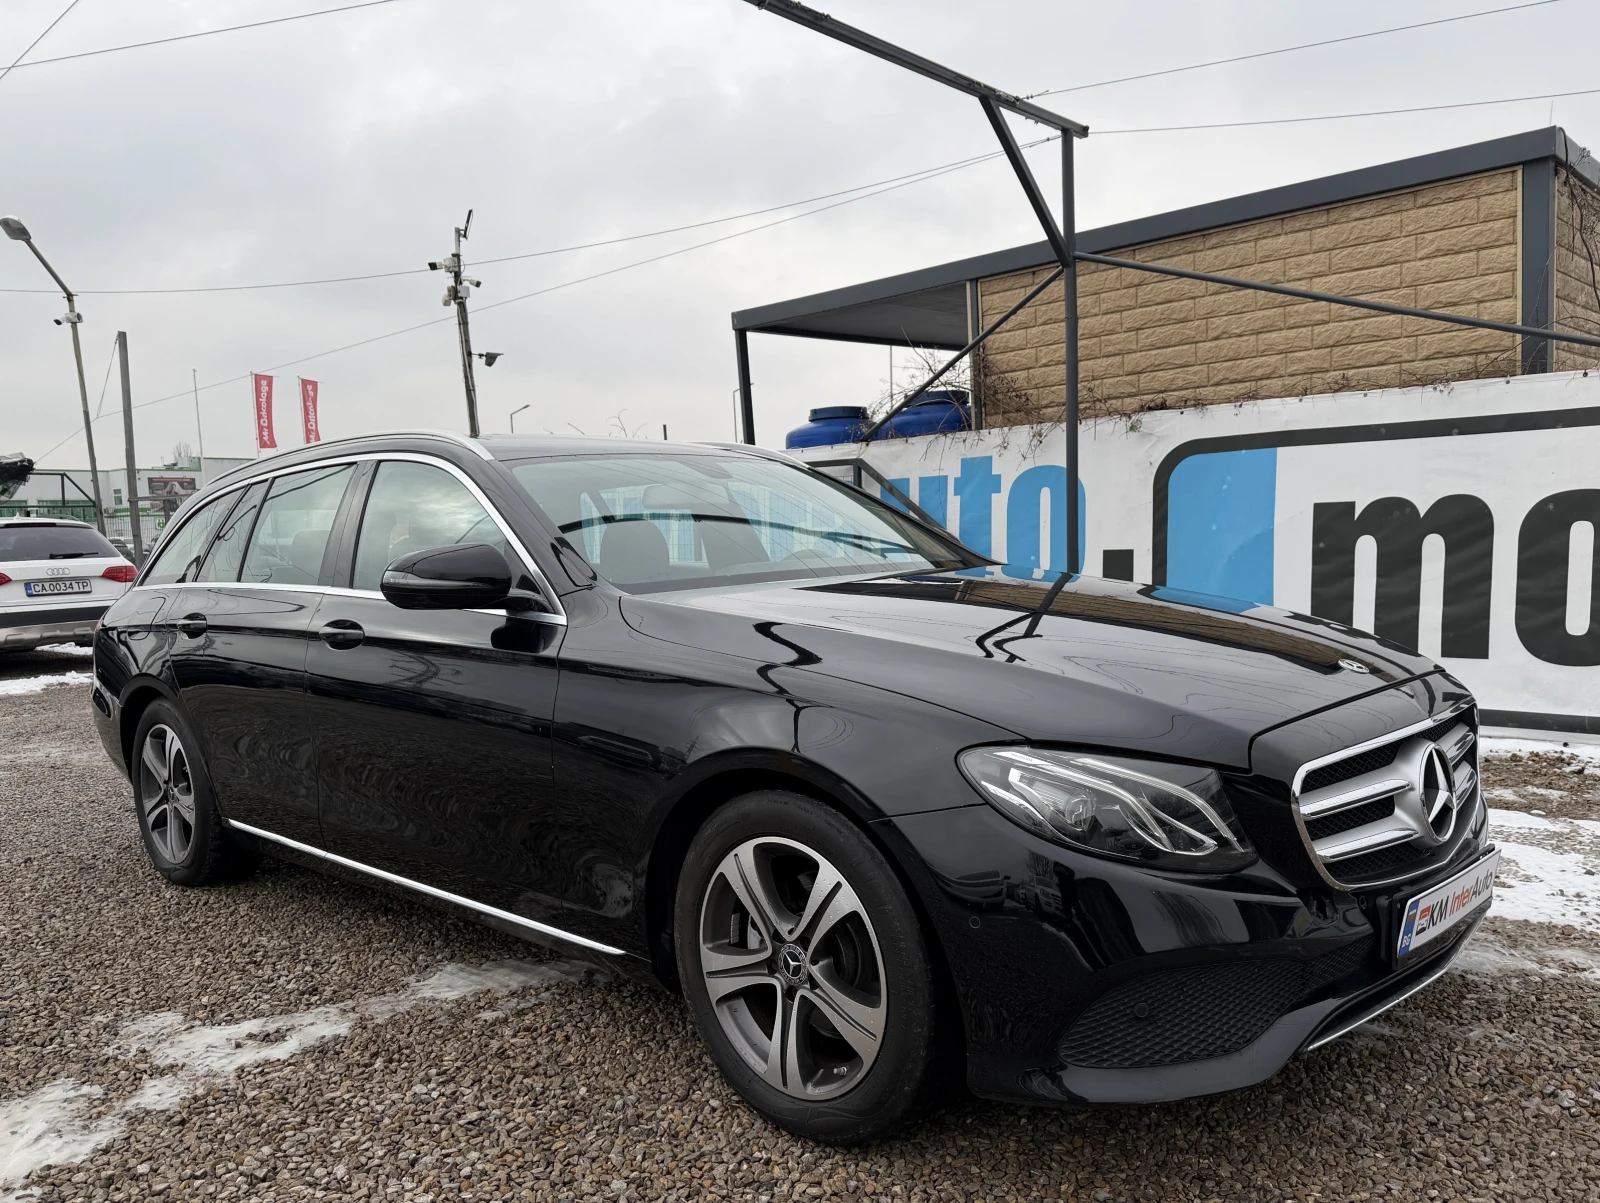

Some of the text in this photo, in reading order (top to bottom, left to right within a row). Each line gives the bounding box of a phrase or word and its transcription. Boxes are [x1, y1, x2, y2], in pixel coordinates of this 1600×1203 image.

[1428, 869, 1492, 929] KM InterAuto
[1401, 934, 1411, 948] BG
